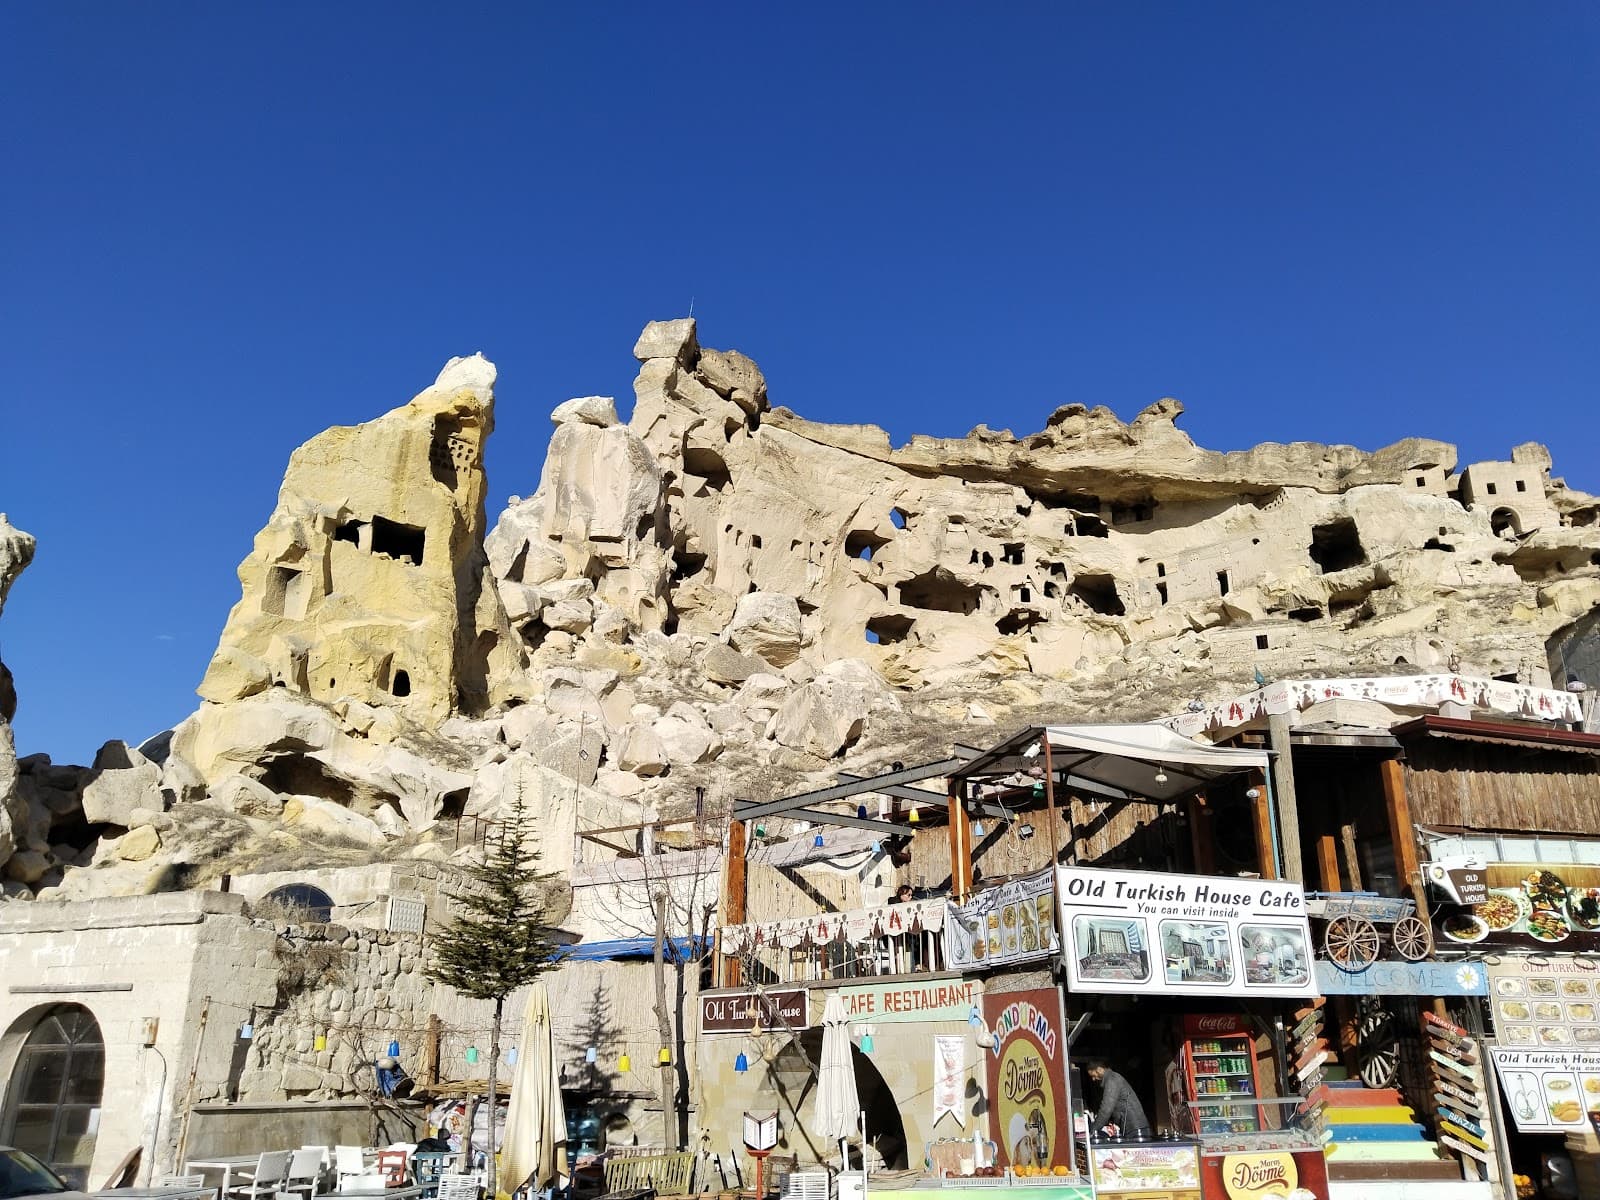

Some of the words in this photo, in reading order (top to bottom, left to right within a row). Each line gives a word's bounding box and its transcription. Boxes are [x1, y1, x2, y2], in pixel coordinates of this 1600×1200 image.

[1466, 874, 1479, 882] OLD
[1068, 878, 1106, 898] Old
[1115, 881, 1186, 902] Turkish
[1195, 885, 1252, 906] House
[1259, 890, 1300, 908] Cafe
[1460, 884, 1486, 893] TURKISH
[1137, 902, 1157, 913] You
[1161, 906, 1179, 914] can
[1183, 905, 1205, 916] visit
[1209, 907, 1240, 918] inside
[1329, 967, 1446, 988] WELCOME
[884, 983, 973, 1012] RESTAURANT
[705, 1001, 725, 1020] Old
[728, 998, 764, 1020] Turh
[1499, 1053, 1520, 1063] Old
[1525, 1053, 1567, 1064] Turkish
[1449, 1112, 1477, 1132] BRAZIL
